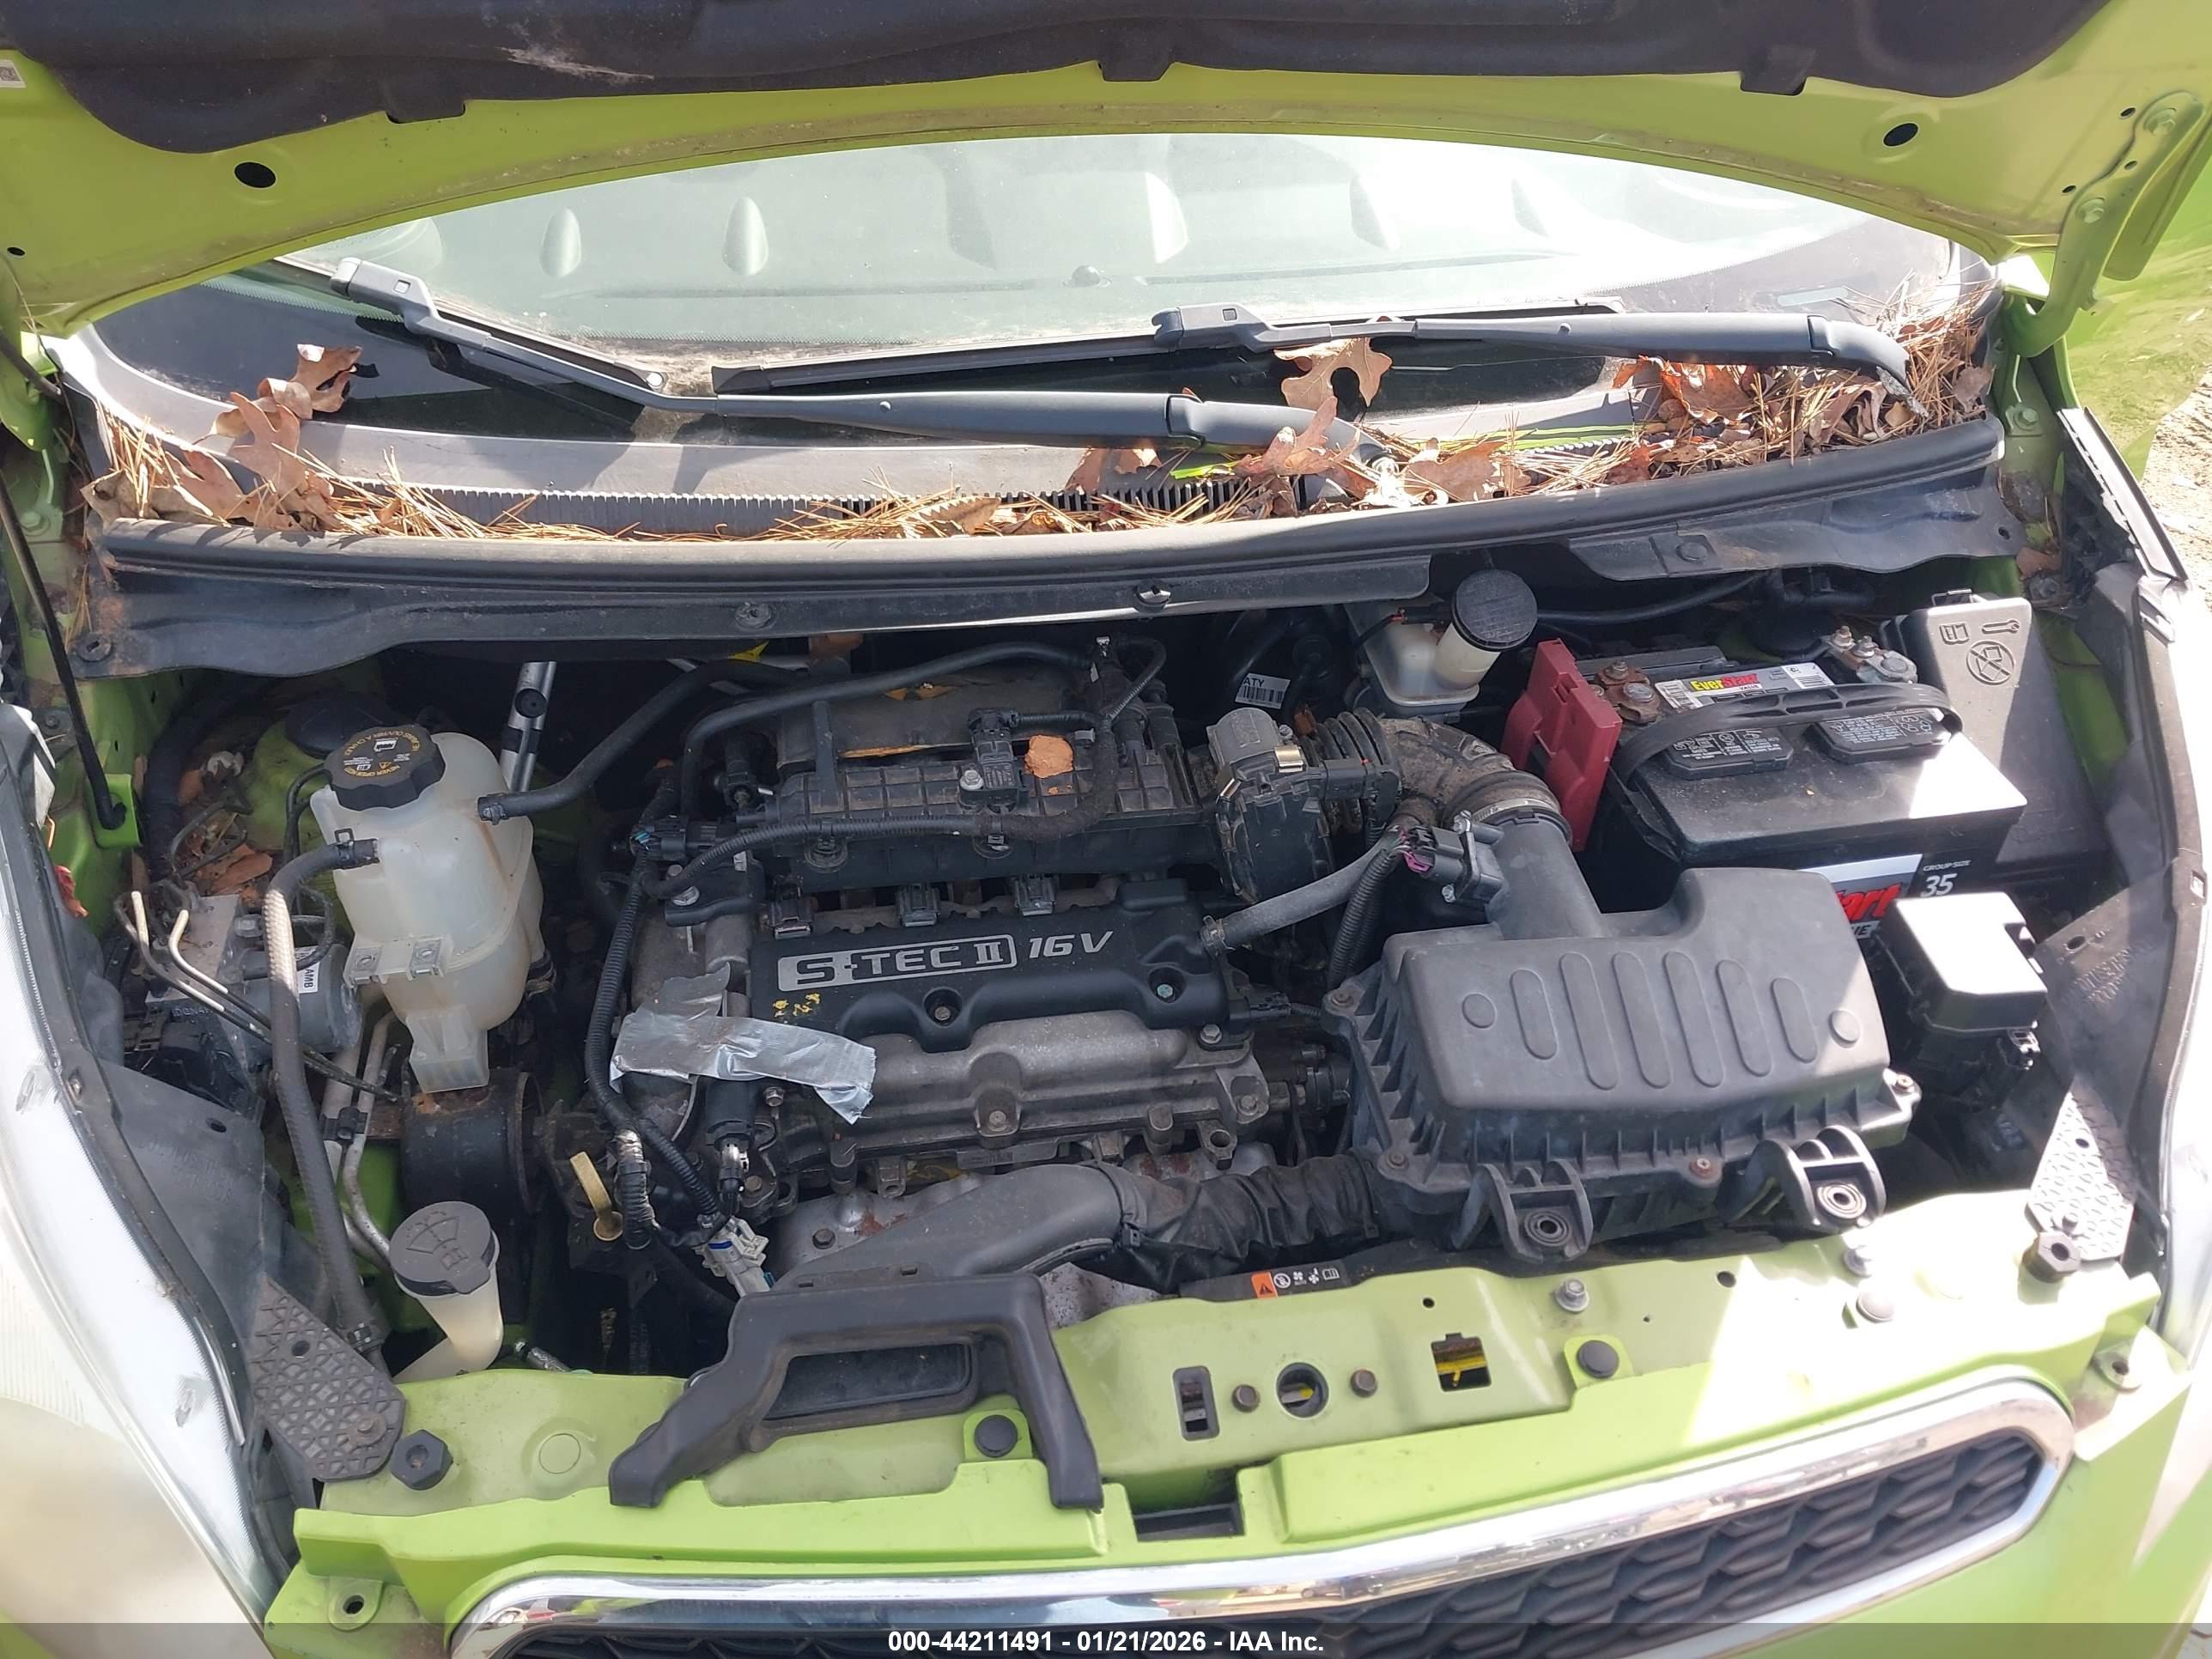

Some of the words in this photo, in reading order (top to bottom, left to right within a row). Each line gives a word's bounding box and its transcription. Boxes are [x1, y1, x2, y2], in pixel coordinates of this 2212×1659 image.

[1690, 673, 1759, 691] EverStart
[1920, 872, 1958, 898] 35
[1029, 930, 1114, 959] 16V
